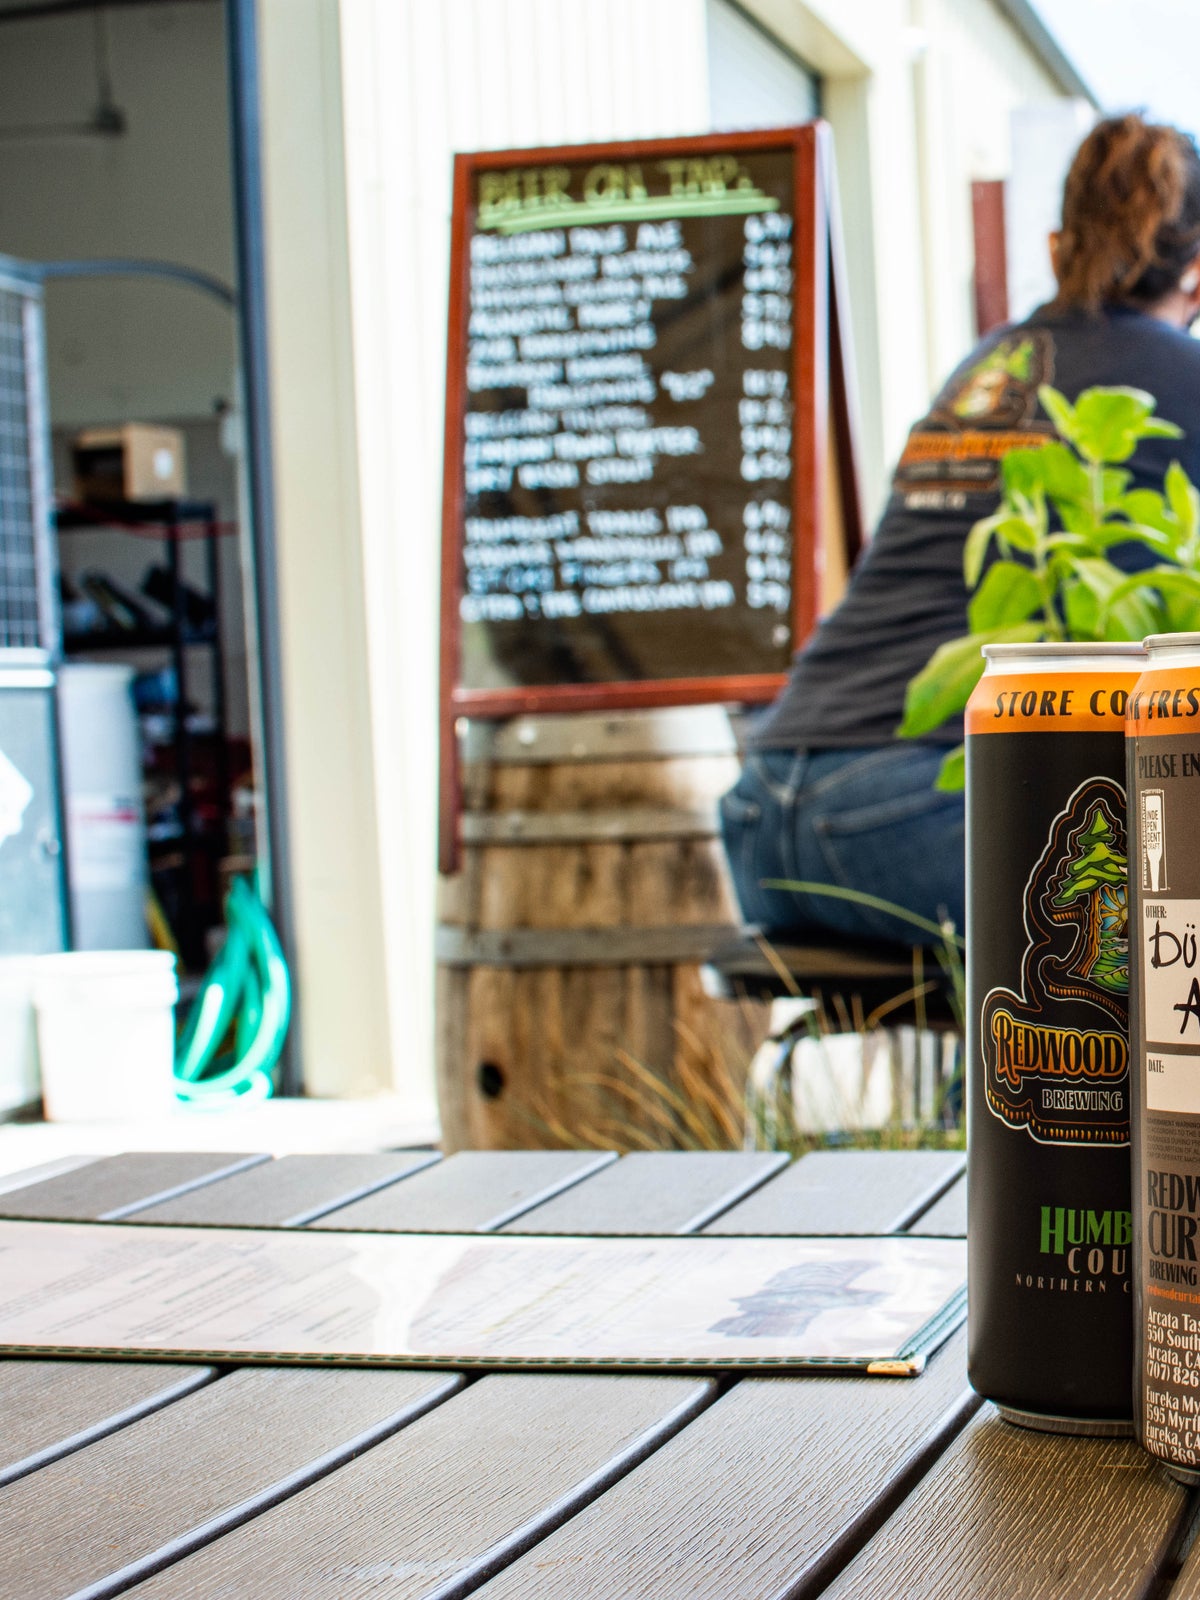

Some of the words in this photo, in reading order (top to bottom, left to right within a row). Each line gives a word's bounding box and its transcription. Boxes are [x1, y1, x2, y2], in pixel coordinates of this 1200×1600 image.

[994, 690, 1074, 717] STORE
[1139, 753, 1178, 779] PLEASE
[1147, 821, 1157, 831] PEN
[1147, 832, 1160, 843] DENT
[1146, 905, 1167, 919] OTHER:
[991, 1010, 1128, 1086] REDWOOD
[1148, 1059, 1165, 1074] DATE:
[1042, 1089, 1123, 1111] BREWING
[1040, 1206, 1132, 1255] HUMB
[1067, 1247, 1126, 1275] COU
[1149, 1259, 1197, 1286] BREWING
[1015, 1273, 1106, 1293] NORTHERN
[1147, 1306, 1179, 1329] Arcata
[1147, 1324, 1164, 1345] 550
[1147, 1342, 1182, 1367] Arcata,
[1146, 1359, 1170, 1382] (707)
[1146, 1385, 1179, 1410] Eureka
[1146, 1420, 1182, 1448] Eureka,
